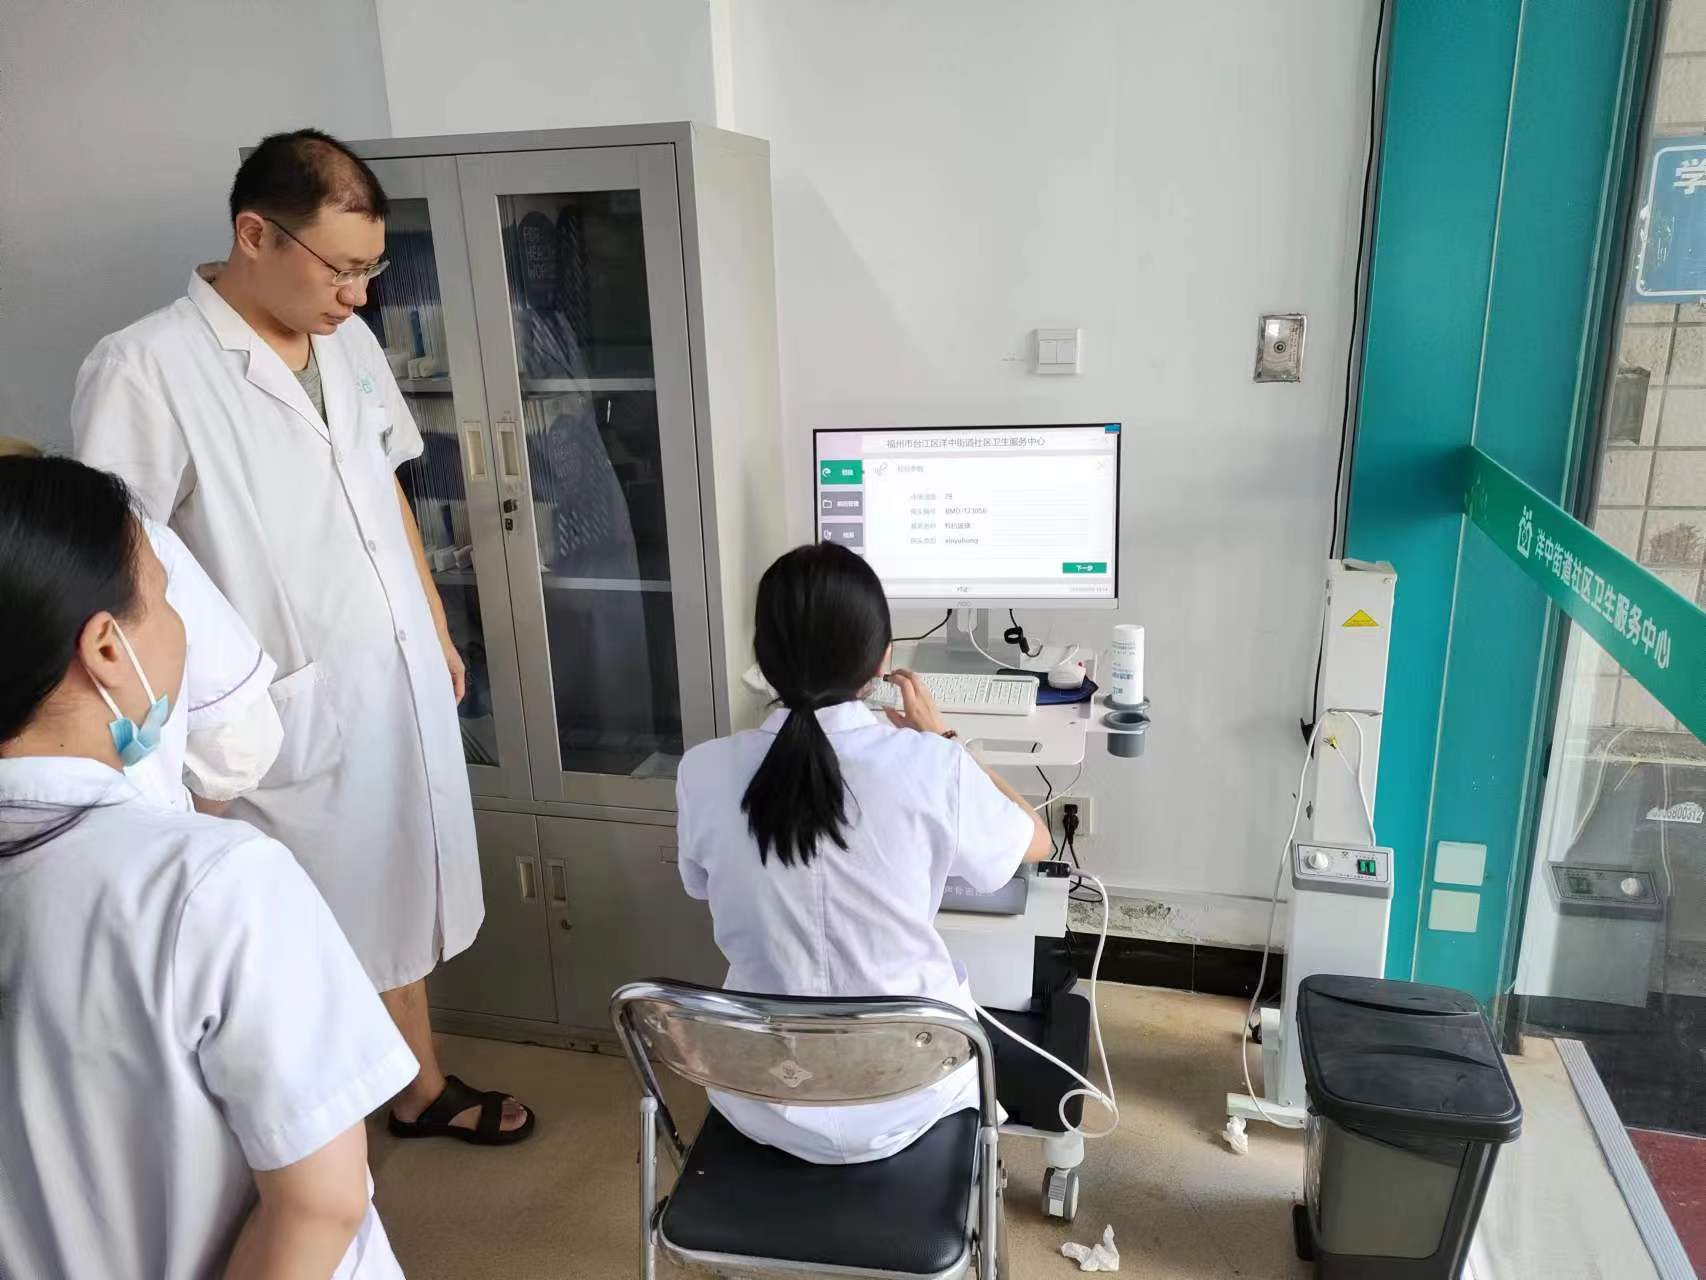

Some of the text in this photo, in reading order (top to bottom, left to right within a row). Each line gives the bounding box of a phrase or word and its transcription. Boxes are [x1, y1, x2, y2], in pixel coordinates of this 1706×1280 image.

[887, 437, 1045, 449] 福州市台江区洋中街道社区卫生服务中心
[1535, 528, 1671, 669] 洋中街道社区卫生服务中心
